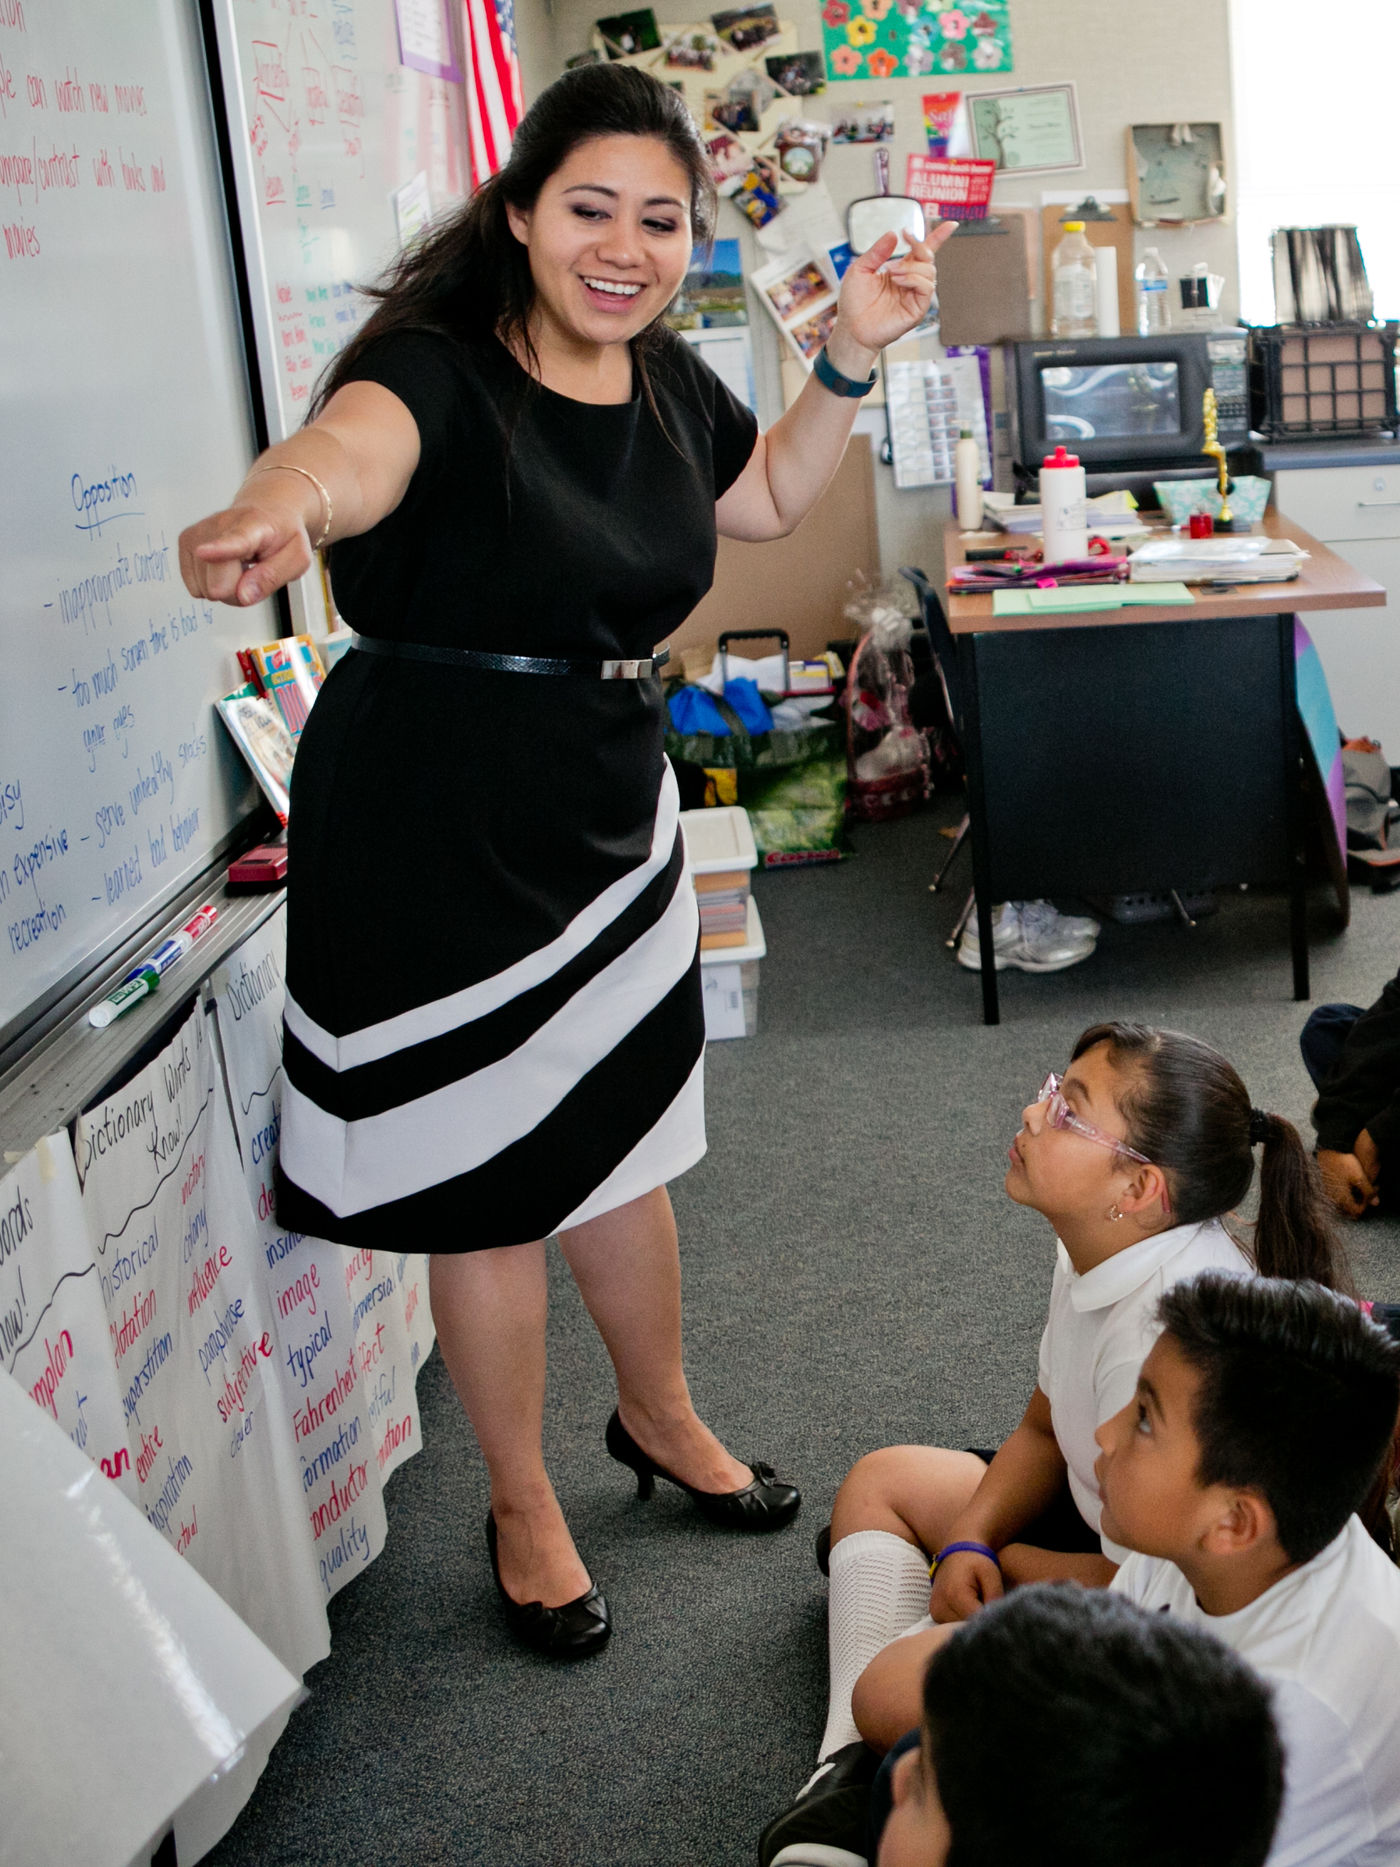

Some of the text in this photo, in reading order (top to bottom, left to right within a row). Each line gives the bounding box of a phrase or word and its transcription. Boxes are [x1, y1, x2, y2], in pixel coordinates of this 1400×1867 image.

[910, 184, 969, 202] REUNION
[911, 171, 970, 188] ALUMNI
[71, 464, 138, 541] Opposition
[13, 824, 69, 897] expensive
[95, 801, 126, 849] serve
[8, 898, 67, 955] recreation
[97, 1214, 159, 1309] historical
[188, 1245, 233, 1318] influence
[276, 1262, 321, 1320] image
[217, 1330, 274, 1424] subjective
[287, 1310, 333, 1388] typical
[292, 1345, 359, 1444] Fahrenheit
[319, 1516, 371, 1593] quality
